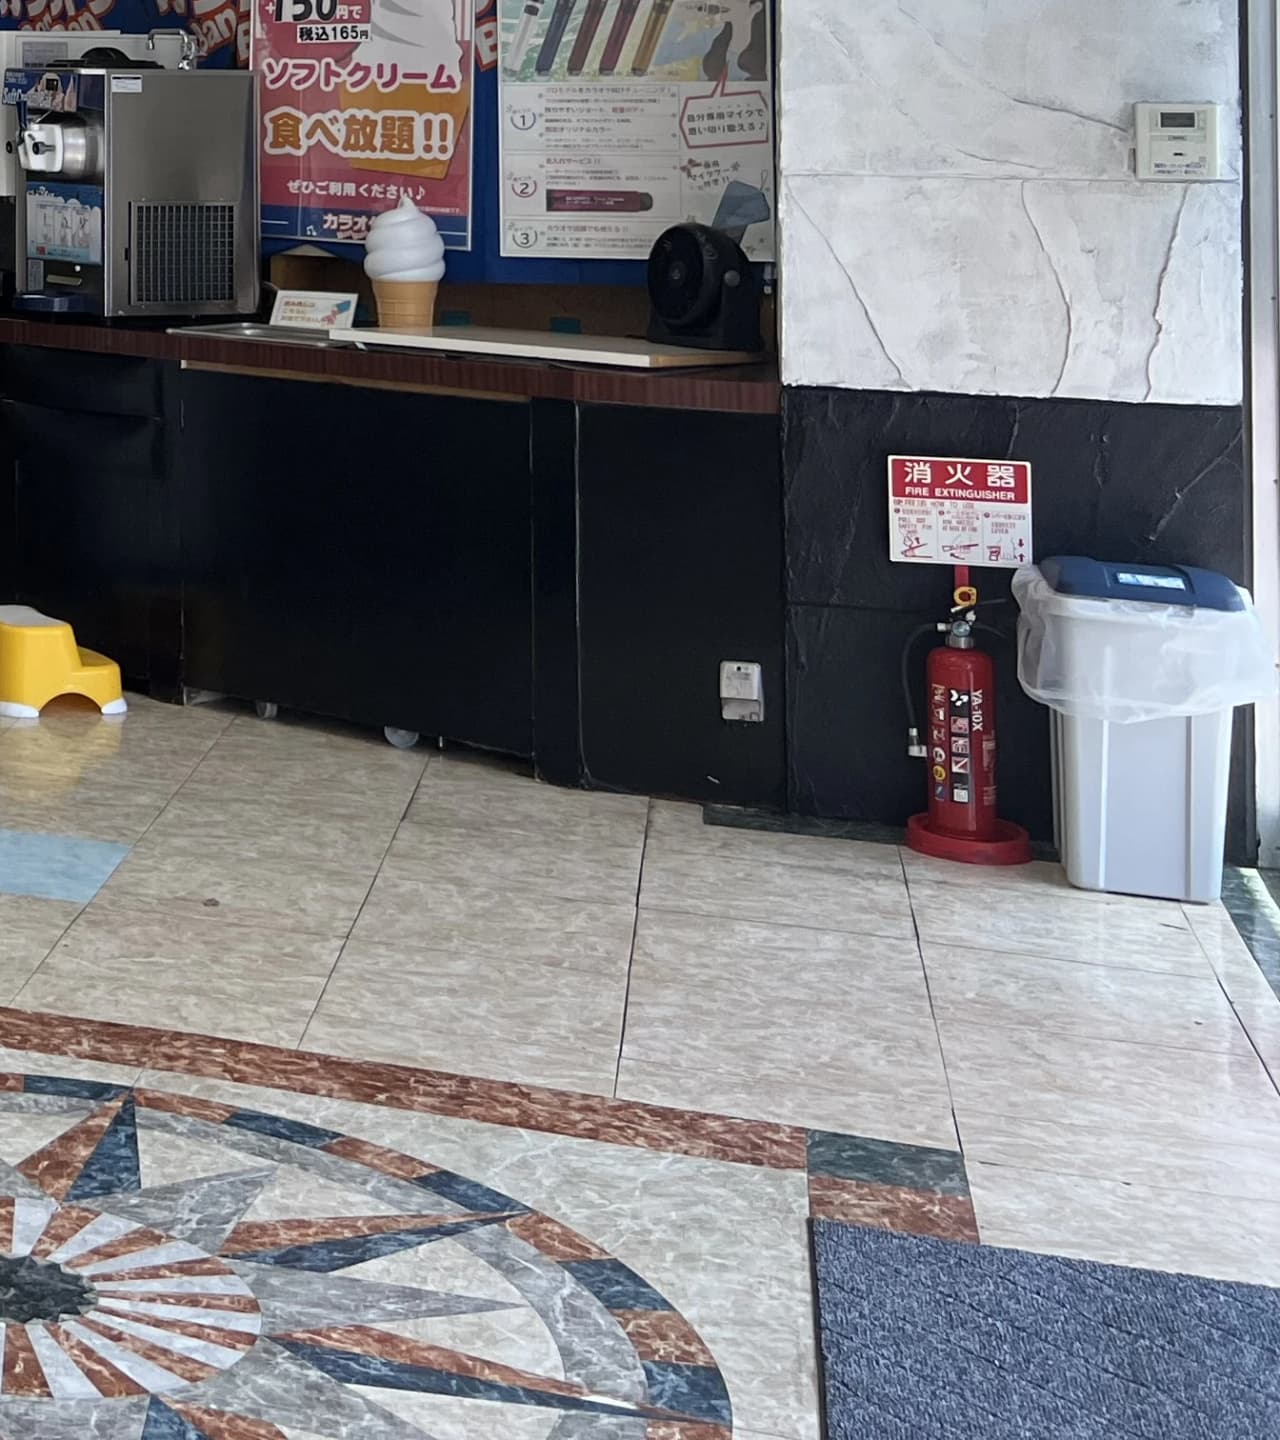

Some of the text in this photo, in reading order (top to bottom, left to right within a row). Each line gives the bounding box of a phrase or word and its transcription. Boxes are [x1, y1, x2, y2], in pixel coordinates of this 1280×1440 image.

[299, 26, 369, 41] 税込165円
[264, 59, 460, 91] ソフトクリーム
[520, 114, 526, 127] 1
[266, 109, 451, 157] 食べ放題!!
[519, 182, 529, 194] 2
[323, 213, 377, 230] カラオ
[520, 232, 529, 244] 3
[904, 461, 1016, 488] 消火器
[905, 486, 1015, 500] FIRE EXTINGUISHER
[971, 689, 984, 731] YA-10X
